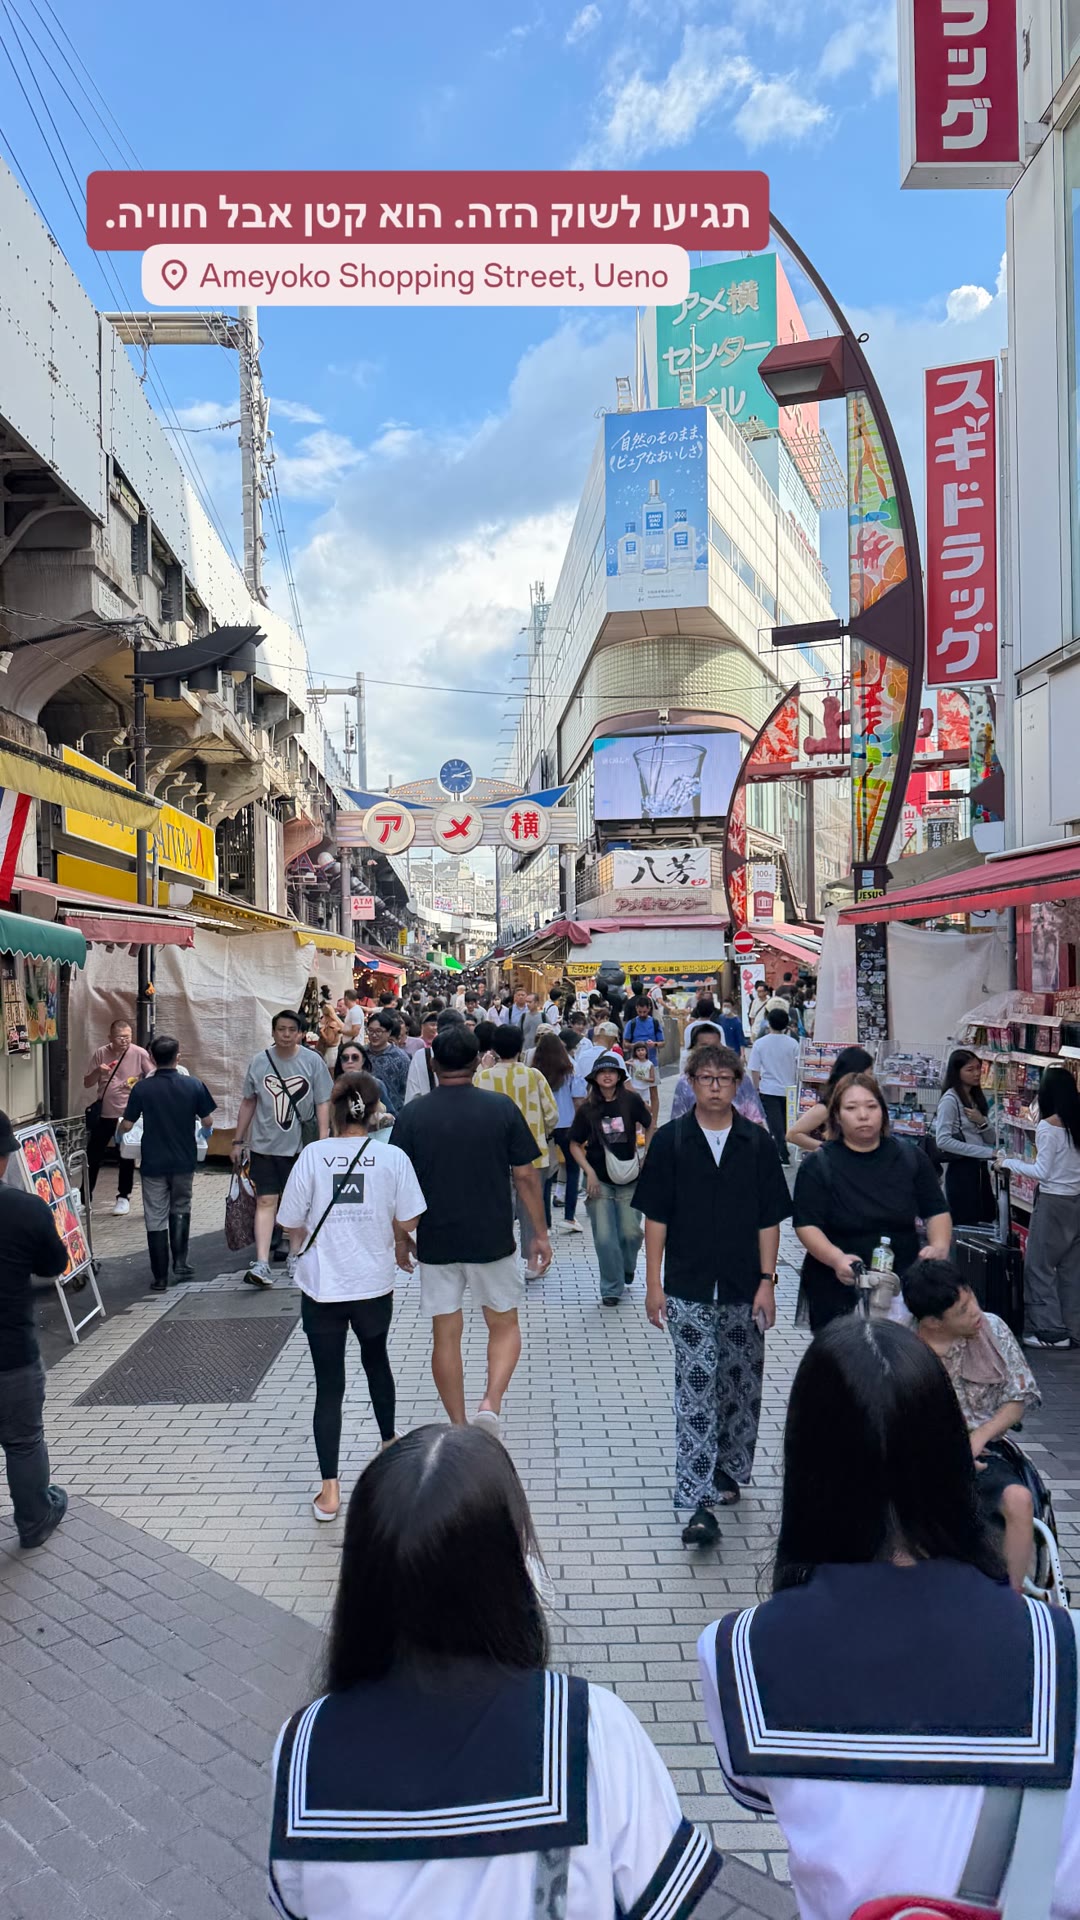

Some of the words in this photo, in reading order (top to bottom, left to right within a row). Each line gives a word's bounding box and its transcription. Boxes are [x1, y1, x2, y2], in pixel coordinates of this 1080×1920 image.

[672, 279, 759, 326] アメ横
[662, 335, 771, 376] センター
[934, 369, 993, 674] スギドラッグ
[374, 811, 540, 845] アメ横
[630, 852, 697, 885] 八芳
